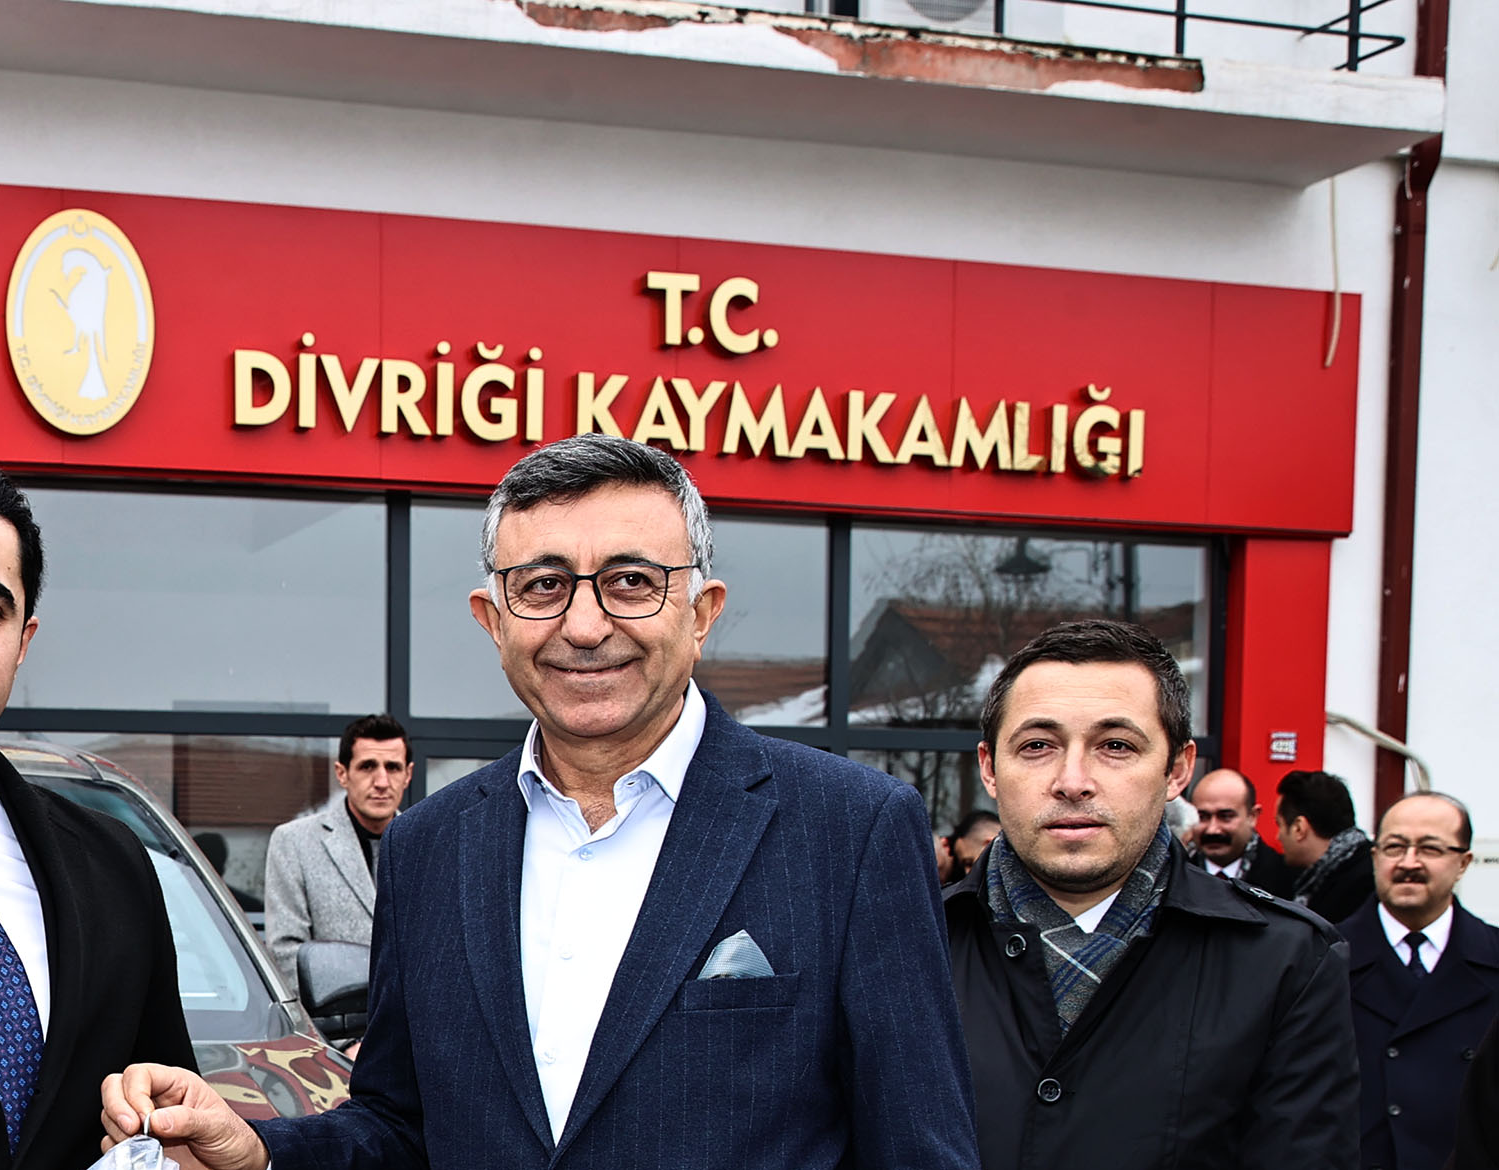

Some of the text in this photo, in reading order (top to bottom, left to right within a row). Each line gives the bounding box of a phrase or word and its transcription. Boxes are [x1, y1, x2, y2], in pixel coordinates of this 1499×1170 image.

[646, 270, 780, 355] T.C.
[233, 331, 1146, 478] DİVRİĞİ KAYMAKAMLIĞI
